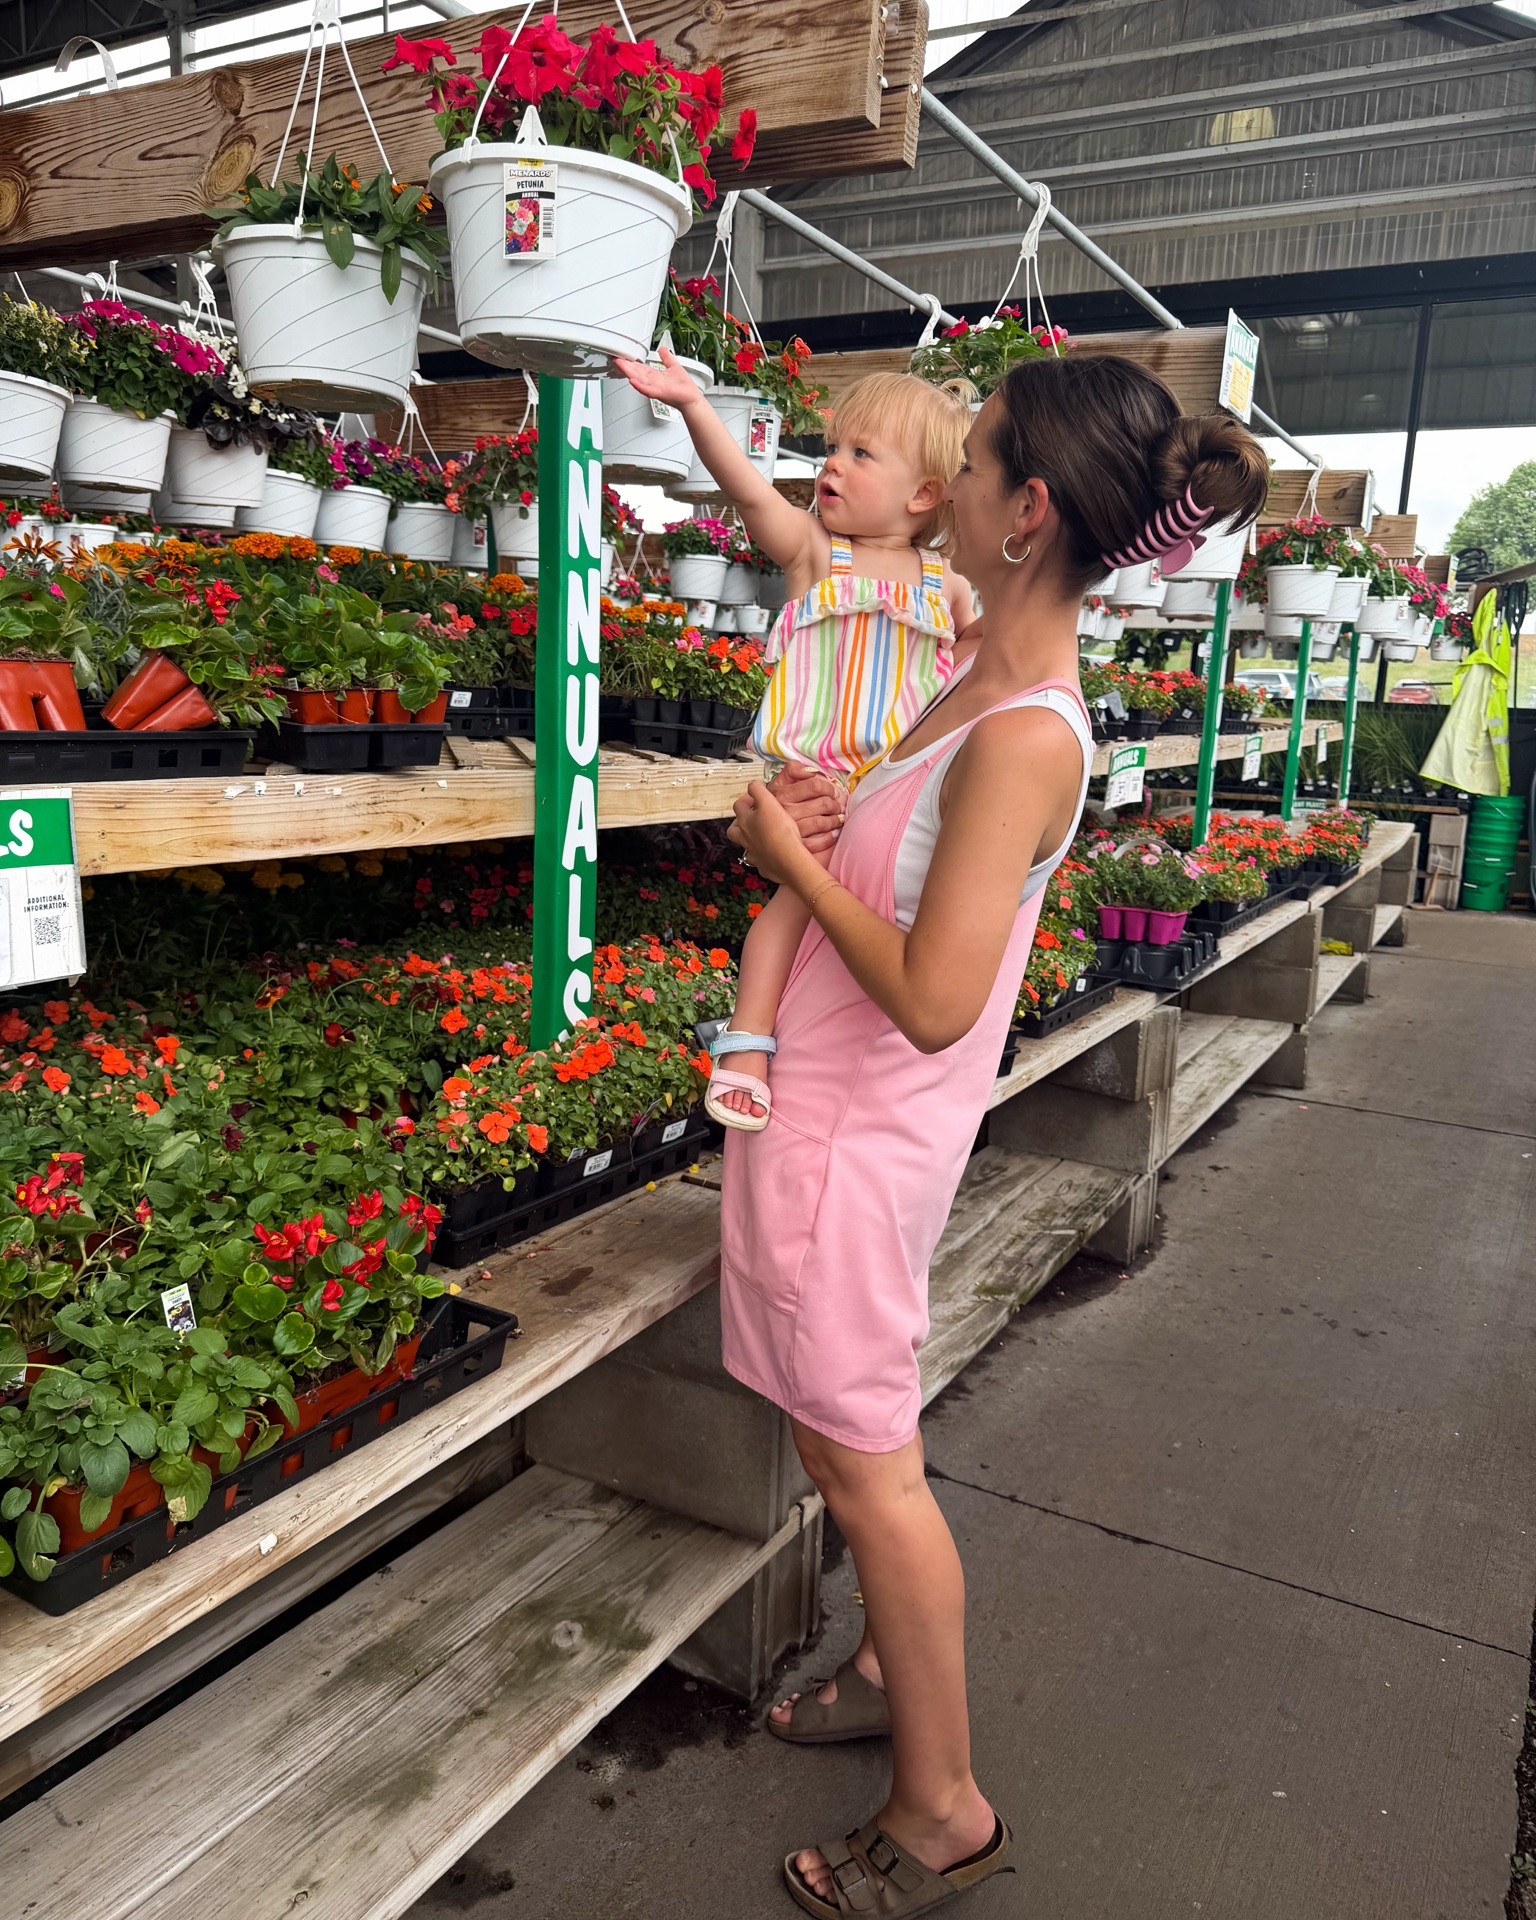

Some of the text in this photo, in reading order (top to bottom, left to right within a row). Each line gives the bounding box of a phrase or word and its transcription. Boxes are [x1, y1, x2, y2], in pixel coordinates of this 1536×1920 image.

[510, 170, 551, 178] MENARDS
[517, 180, 544, 189] PETUNIA
[558, 379, 604, 1043] ANNUALS
[28, 894, 65, 904] ADDITIONAL
[24, 901, 70, 912] INFORMATION:
